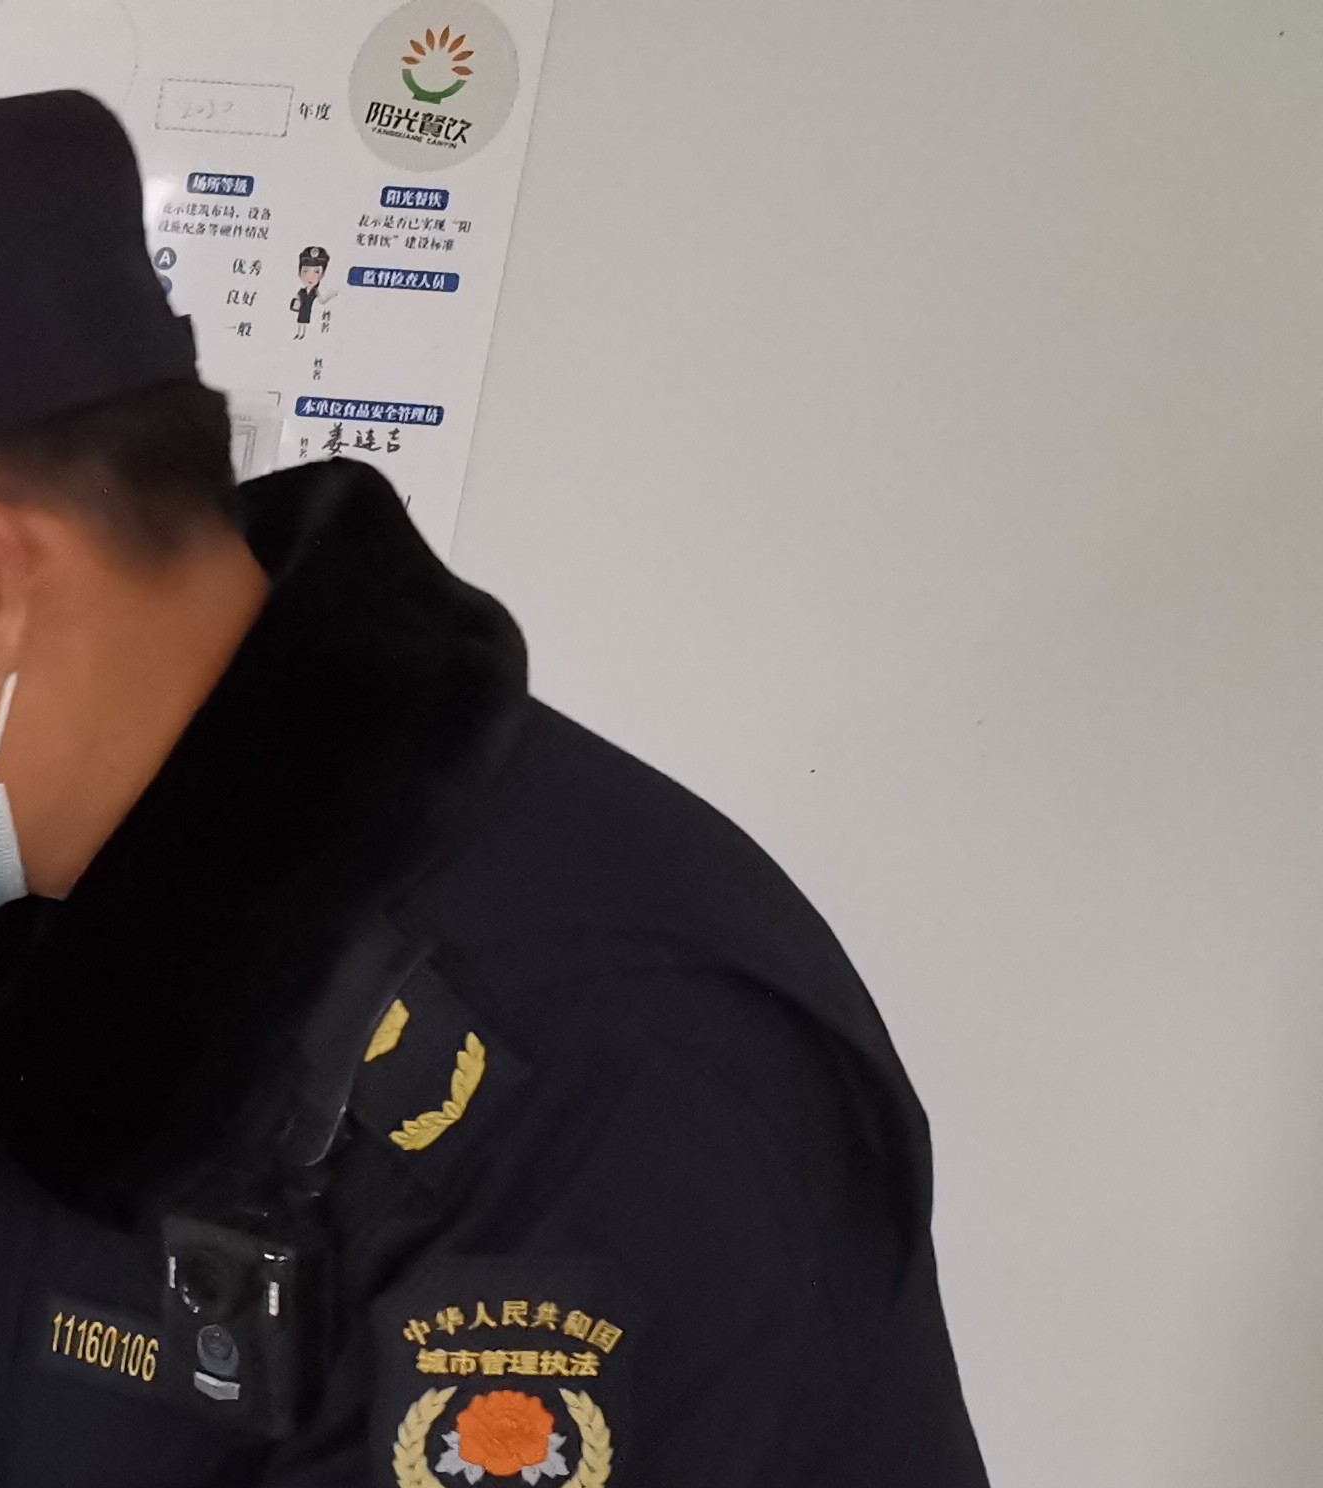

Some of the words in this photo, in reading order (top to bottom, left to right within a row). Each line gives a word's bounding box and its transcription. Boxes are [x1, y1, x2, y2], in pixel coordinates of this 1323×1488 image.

[192, 174, 248, 194] 场所等级
[385, 189, 444, 208] 阳光餐饮
[158, 250, 172, 266] A
[232, 257, 262, 276] 优秀
[362, 269, 446, 290] 监督检查人员
[226, 288, 257, 306] 良好
[301, 398, 439, 424] 本单位食品安全管理员
[403, 1300, 624, 1354] 中华人民共和国
[51, 1311, 160, 1382] 11160106
[415, 1348, 601, 1376] 城市管理执法
